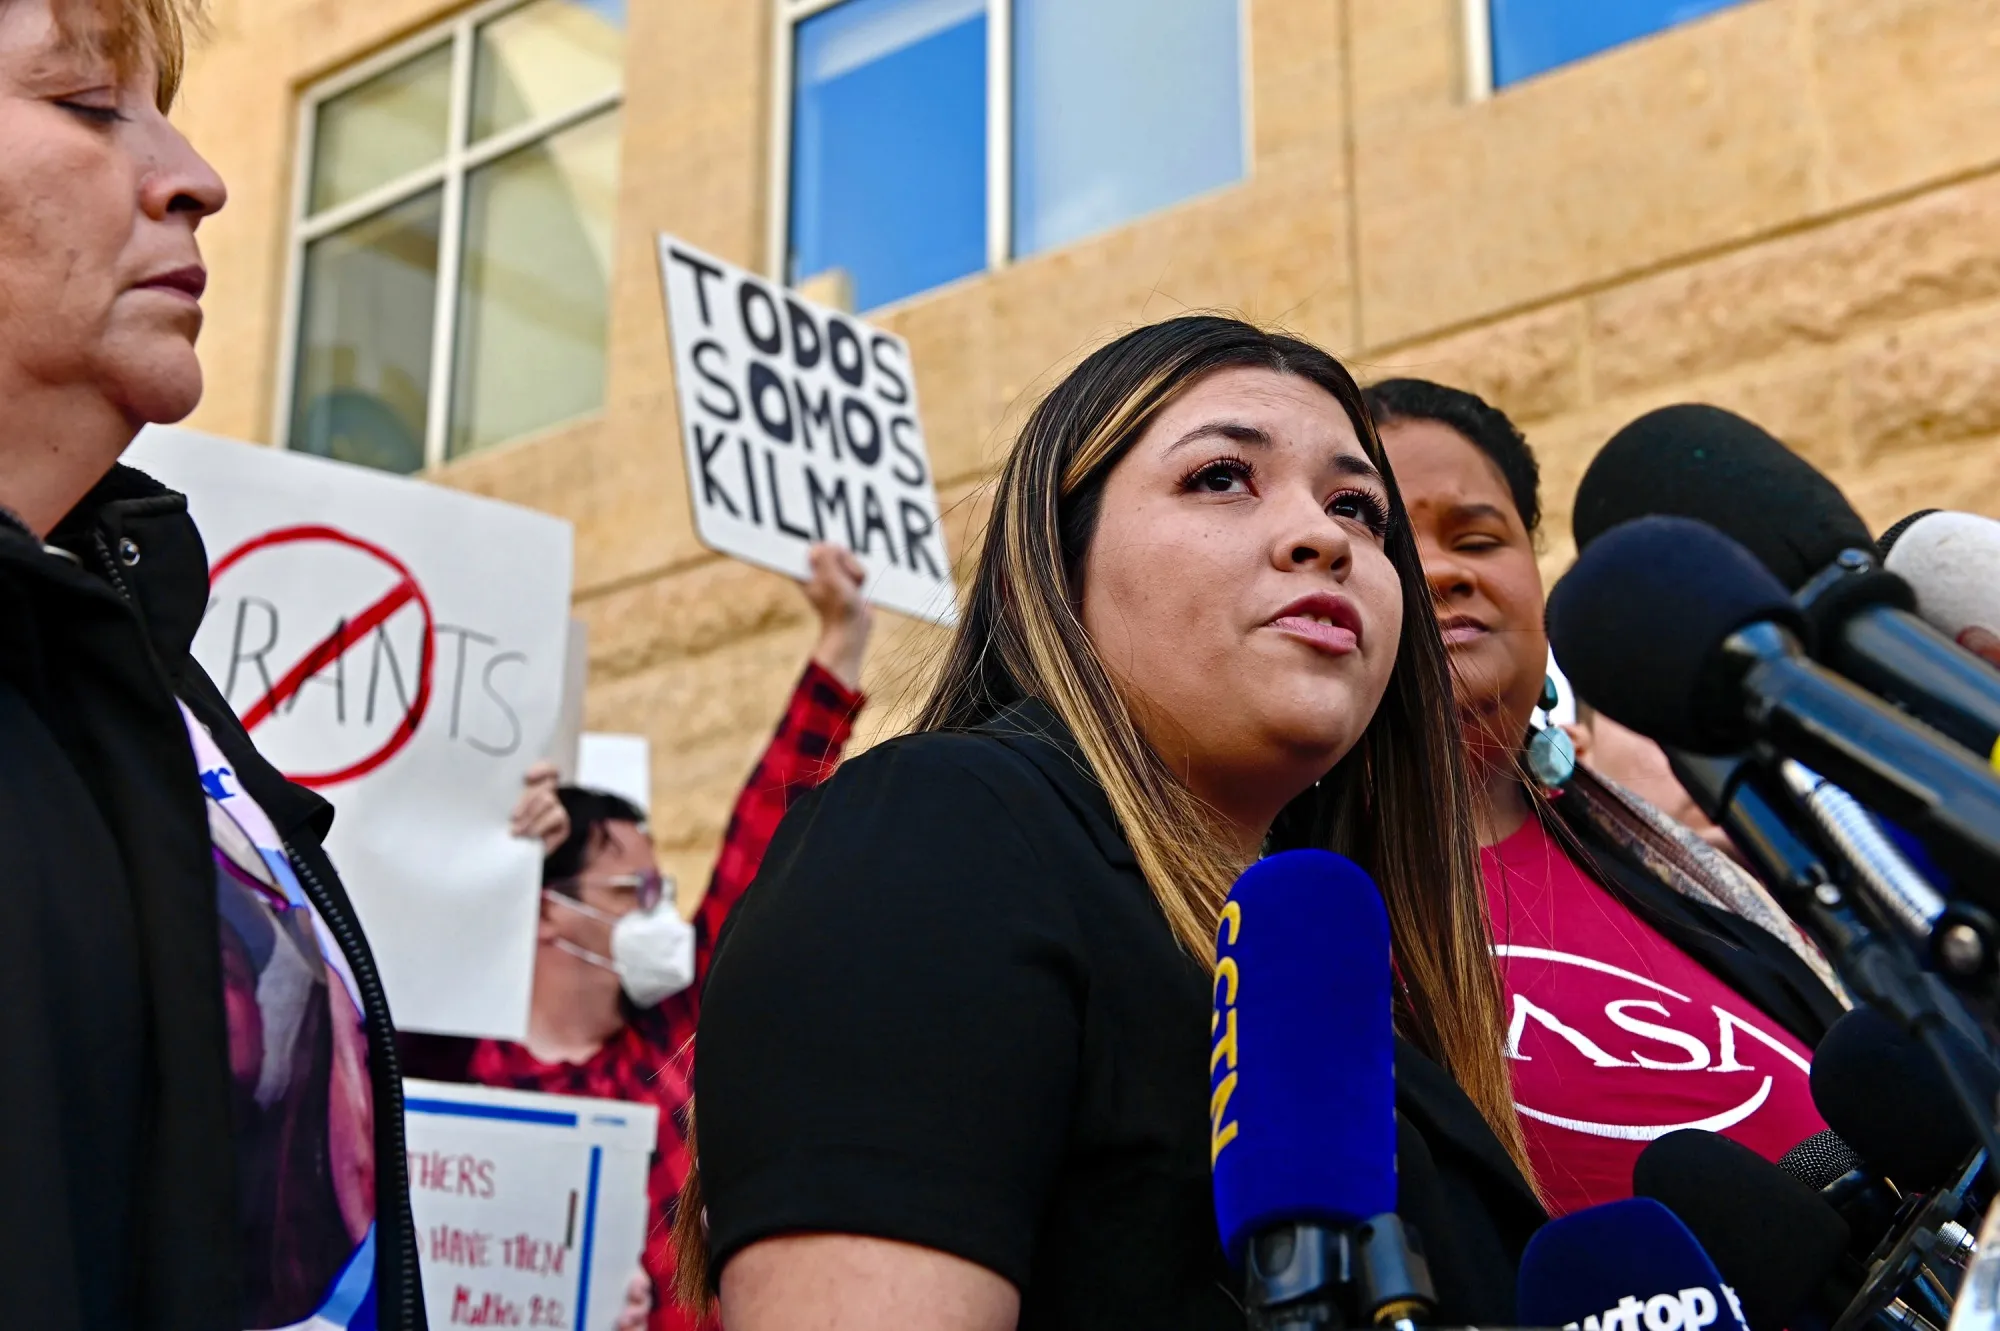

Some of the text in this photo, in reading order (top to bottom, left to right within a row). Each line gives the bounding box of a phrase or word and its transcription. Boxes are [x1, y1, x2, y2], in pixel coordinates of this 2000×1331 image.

[669, 246, 908, 406] TODOS
[692, 340, 925, 487] SOMOS
[694, 425, 941, 580] KILMAR
[203, 596, 529, 757] RANTS
[430, 1224, 491, 1269] HAVE
